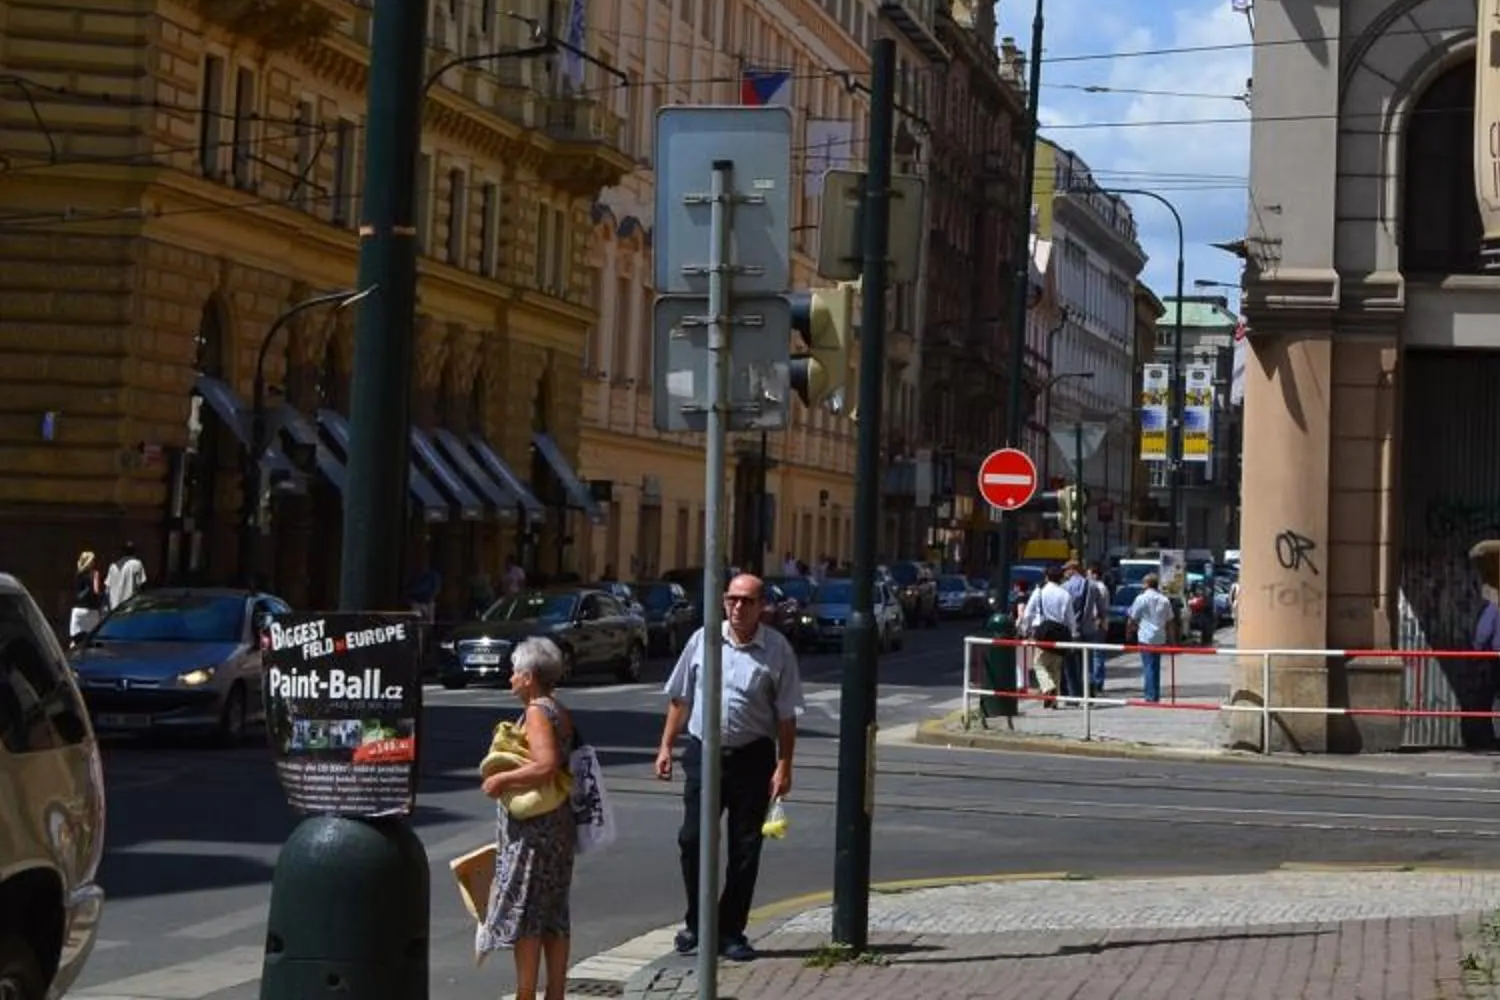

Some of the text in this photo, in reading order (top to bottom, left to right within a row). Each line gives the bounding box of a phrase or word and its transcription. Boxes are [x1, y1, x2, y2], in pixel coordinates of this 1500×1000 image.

[270, 619, 325, 651] BIGGEST
[302, 637, 335, 660] FIELD
[345, 623, 406, 649] EUROPE
[269, 667, 403, 699] Paint-Ball.cz
